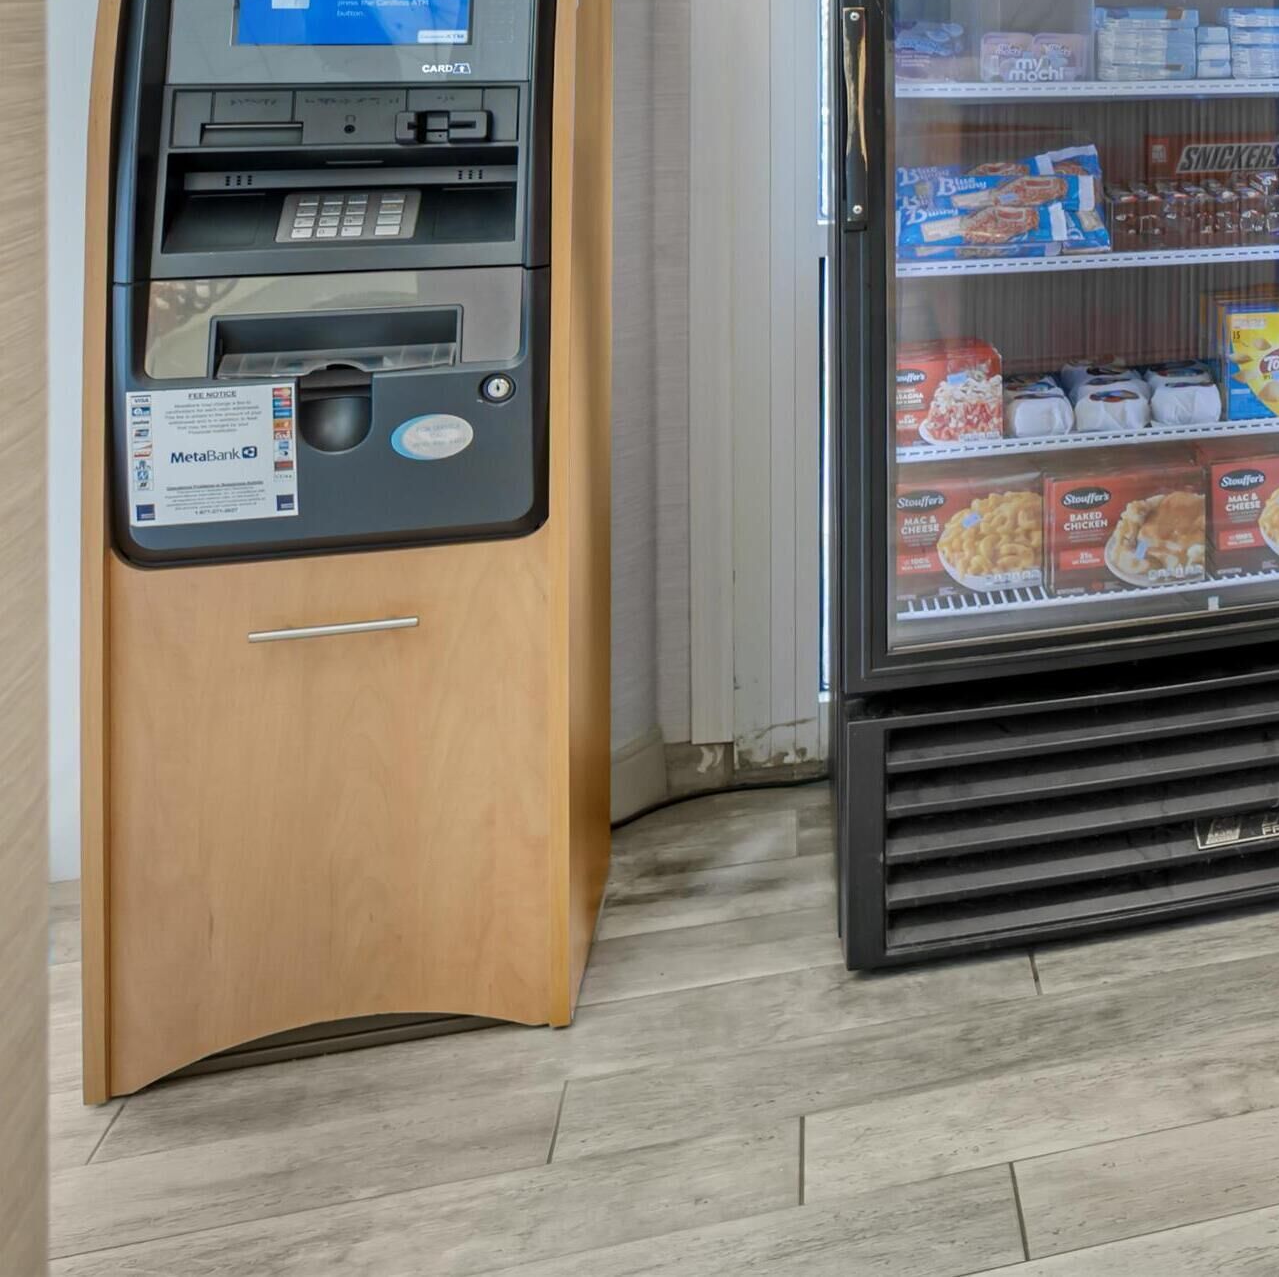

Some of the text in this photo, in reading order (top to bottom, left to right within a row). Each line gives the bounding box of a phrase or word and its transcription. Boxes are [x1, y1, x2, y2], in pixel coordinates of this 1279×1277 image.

[422, 64, 452, 74] CARD
[1015, 57, 1044, 73] my
[1010, 67, 1063, 83] mochi
[206, 390, 237, 399] NOTICE
[170, 448, 241, 464] MetaBank
[1220, 474, 1265, 488] Stouffer's
[896, 495, 945, 509] Stouffer's
[1063, 493, 1110, 506] Stouffer's
[1228, 494, 1249, 503] MAC
[1225, 501, 1261, 512] CHEESE
[904, 515, 937, 526] MAC &
[1069, 512, 1102, 522] BAKED
[901, 524, 939, 535] CHEESE
[1064, 519, 1108, 531] CHICKEN
